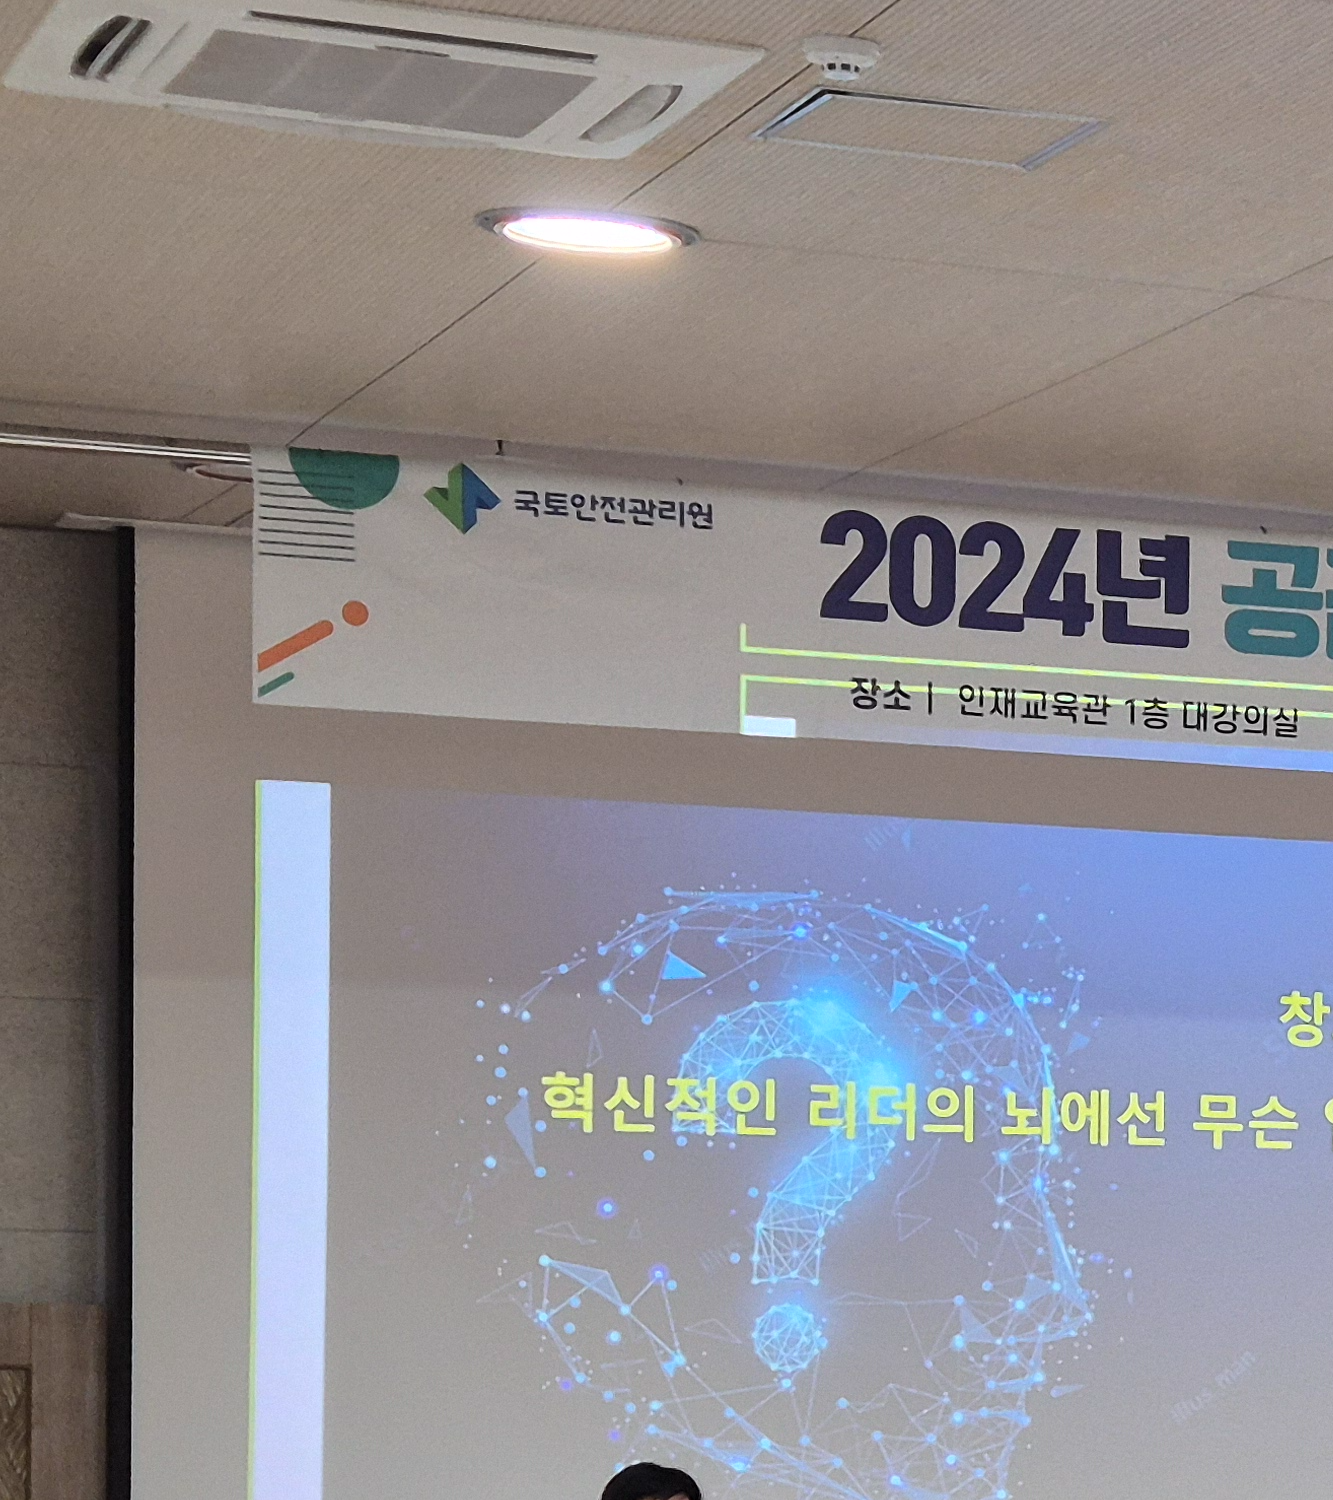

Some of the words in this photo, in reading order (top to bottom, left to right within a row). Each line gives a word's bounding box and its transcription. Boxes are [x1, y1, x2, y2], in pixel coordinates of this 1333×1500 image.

[513, 488, 714, 530] 국토안전관리원
[819, 508, 1191, 650] 2024년
[849, 676, 912, 712] 장소
[957, 684, 1112, 727] 인재교육관
[1123, 696, 1172, 731] 1층
[1181, 700, 1300, 739] 대강의실
[541, 1071, 778, 1138] 혁신적인
[808, 1082, 975, 1143] 리더의
[1001, 1086, 1167, 1147] 뇌에선
[1192, 1093, 1300, 1151] 무슨
